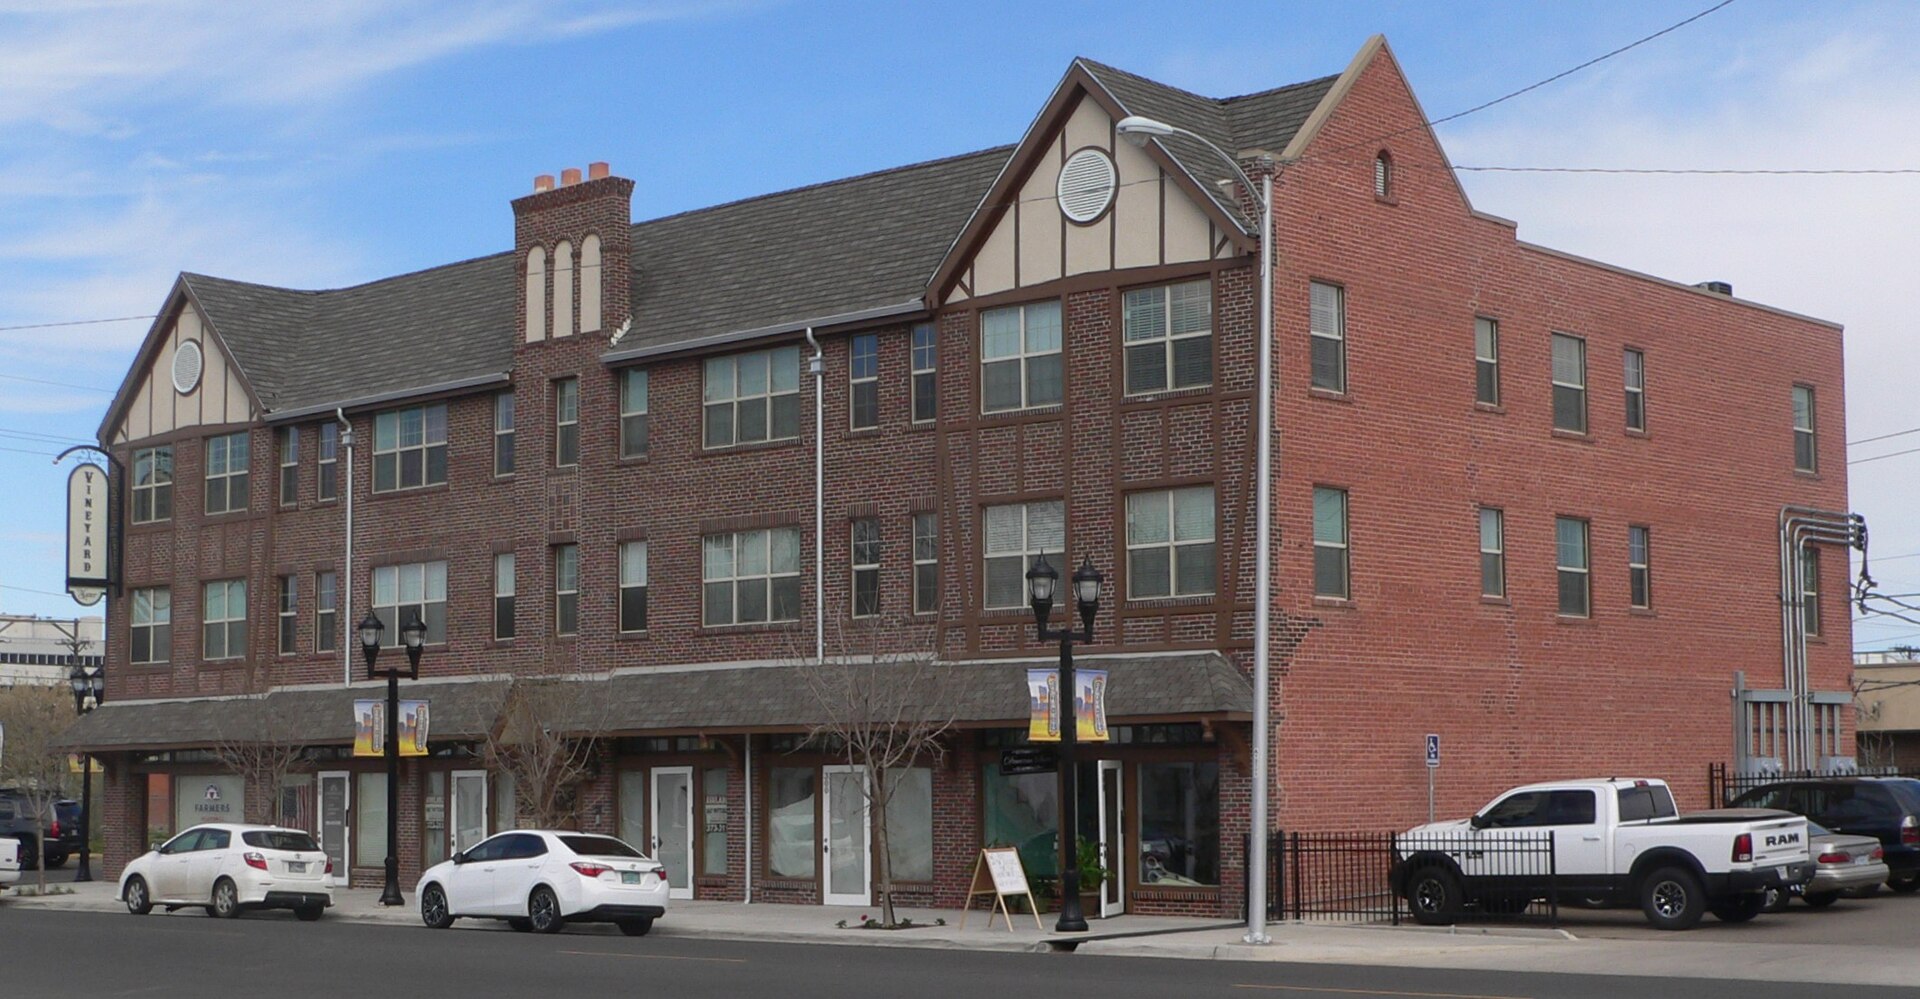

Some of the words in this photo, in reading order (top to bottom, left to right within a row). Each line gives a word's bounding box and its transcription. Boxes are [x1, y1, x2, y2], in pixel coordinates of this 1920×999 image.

[84, 471, 94, 572] VINEYARD
[194, 803, 231, 813] FARMERS
[1765, 832, 1800, 847] RAM
